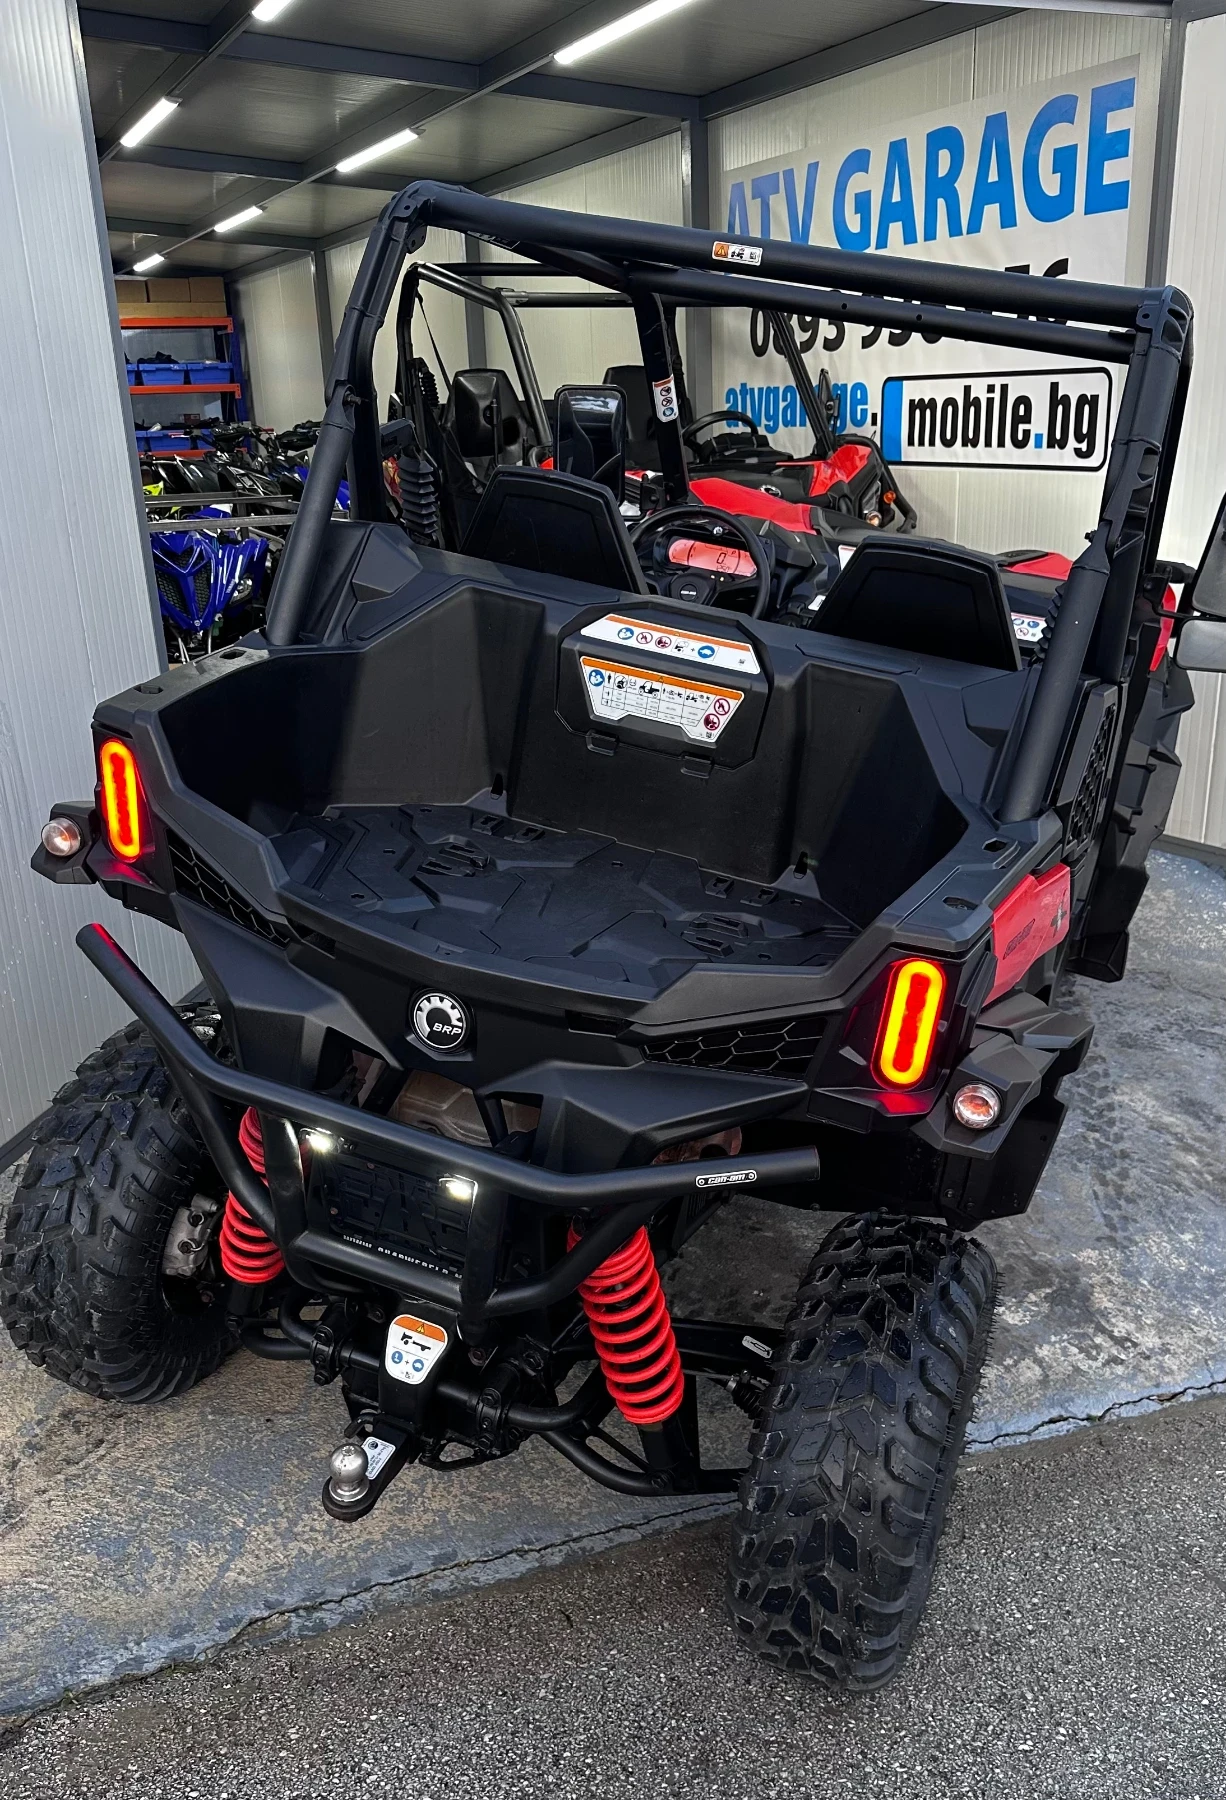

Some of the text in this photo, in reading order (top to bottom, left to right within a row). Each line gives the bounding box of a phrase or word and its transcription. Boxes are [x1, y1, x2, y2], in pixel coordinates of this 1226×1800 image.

[728, 77, 1136, 252] ATV GARAGE
[907, 382, 1100, 460] mobile.bg
[432, 1022, 462, 1036] BRP
